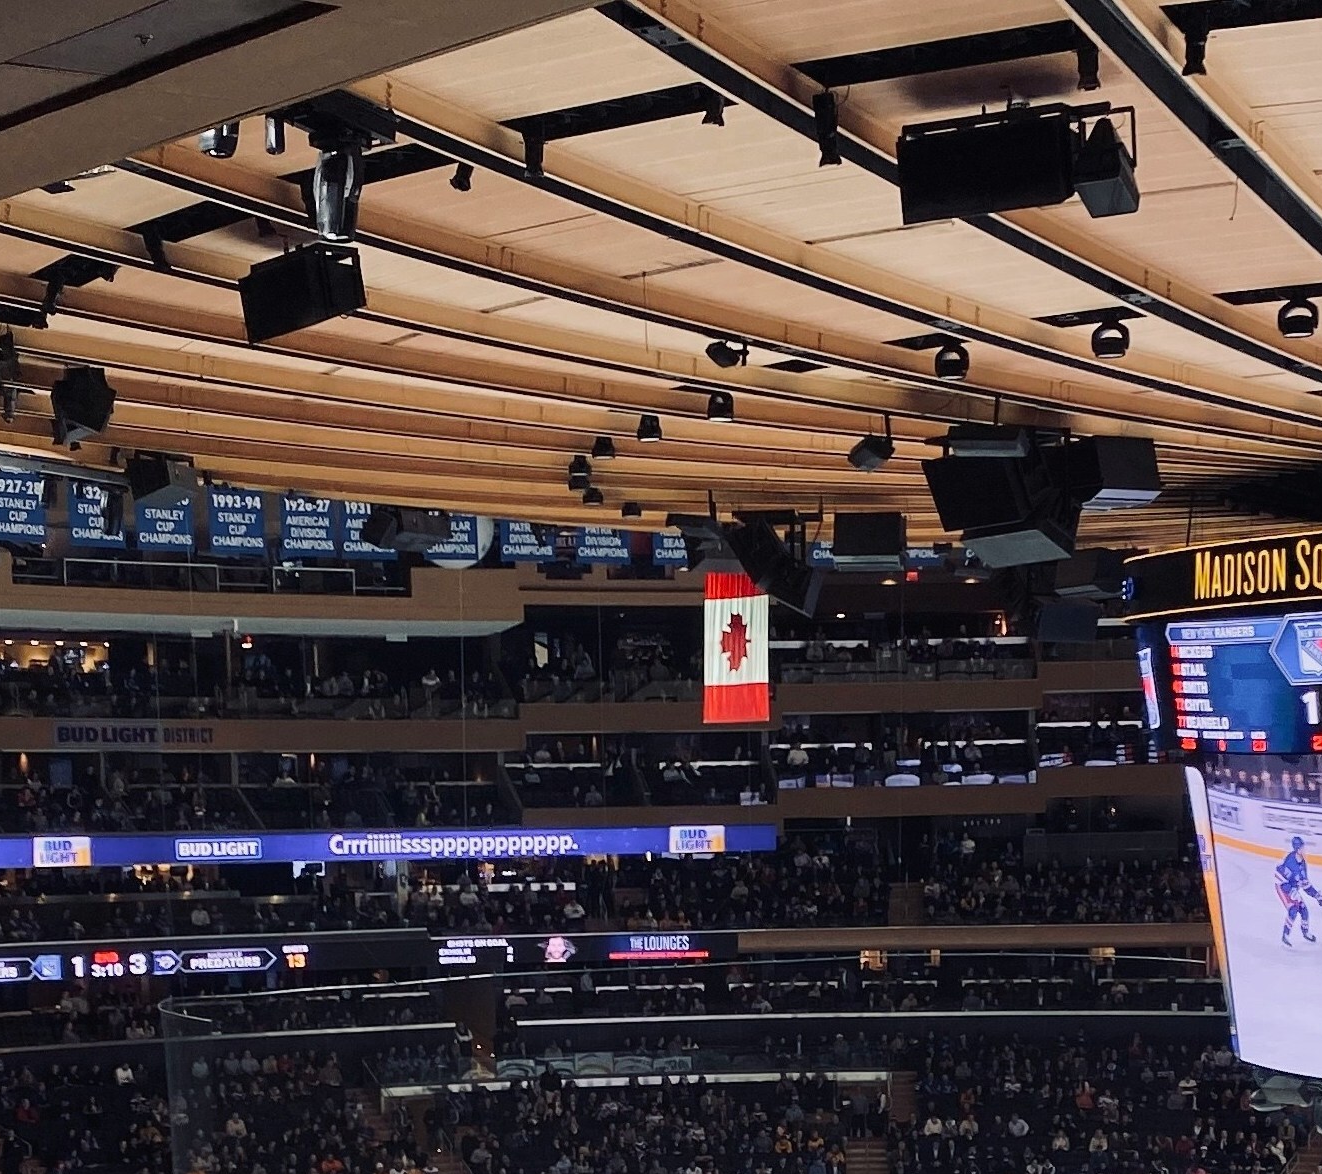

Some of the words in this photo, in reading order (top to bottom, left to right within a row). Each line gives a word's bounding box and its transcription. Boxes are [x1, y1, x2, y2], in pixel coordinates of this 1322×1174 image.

[212, 493, 262, 511] 1993-94
[8, 511, 28, 523] CUP
[144, 508, 184, 521] STANLEY
[217, 511, 257, 524] STANLEY
[156, 521, 175, 533] CUP
[286, 515, 330, 528] AMERICAN
[229, 525, 247, 536] CUP
[290, 526, 327, 539] DIVISION
[139, 532, 193, 546] CHAMPIONS
[212, 536, 264, 549] CHAMPIONS
[283, 538, 335, 551] CHAMPIONS
[584, 536, 622, 547] DIVISION
[577, 547, 630, 559] CHAMPIONS
[1194, 547, 1287, 600] MADISON
[1300, 690, 1321, 725] 1
[57, 726, 99, 743] BUD
[102, 726, 158, 743] LIGHT
[163, 727, 214, 744] DISTRICT
[679, 828, 708, 840] BUD
[44, 839, 73, 851] BUD
[178, 842, 212, 857] BUD
[212, 841, 259, 857] LIGHT
[674, 839, 713, 851] LIGHT
[39, 850, 79, 865] LIGHT
[644, 935, 690, 950] LOUNGES
[70, 956, 85, 978] 1
[129, 953, 148, 976] 3
[189, 956, 262, 970] PREDATORS
[286, 953, 307, 968] 13
[90, 963, 125, 978] 3:10
